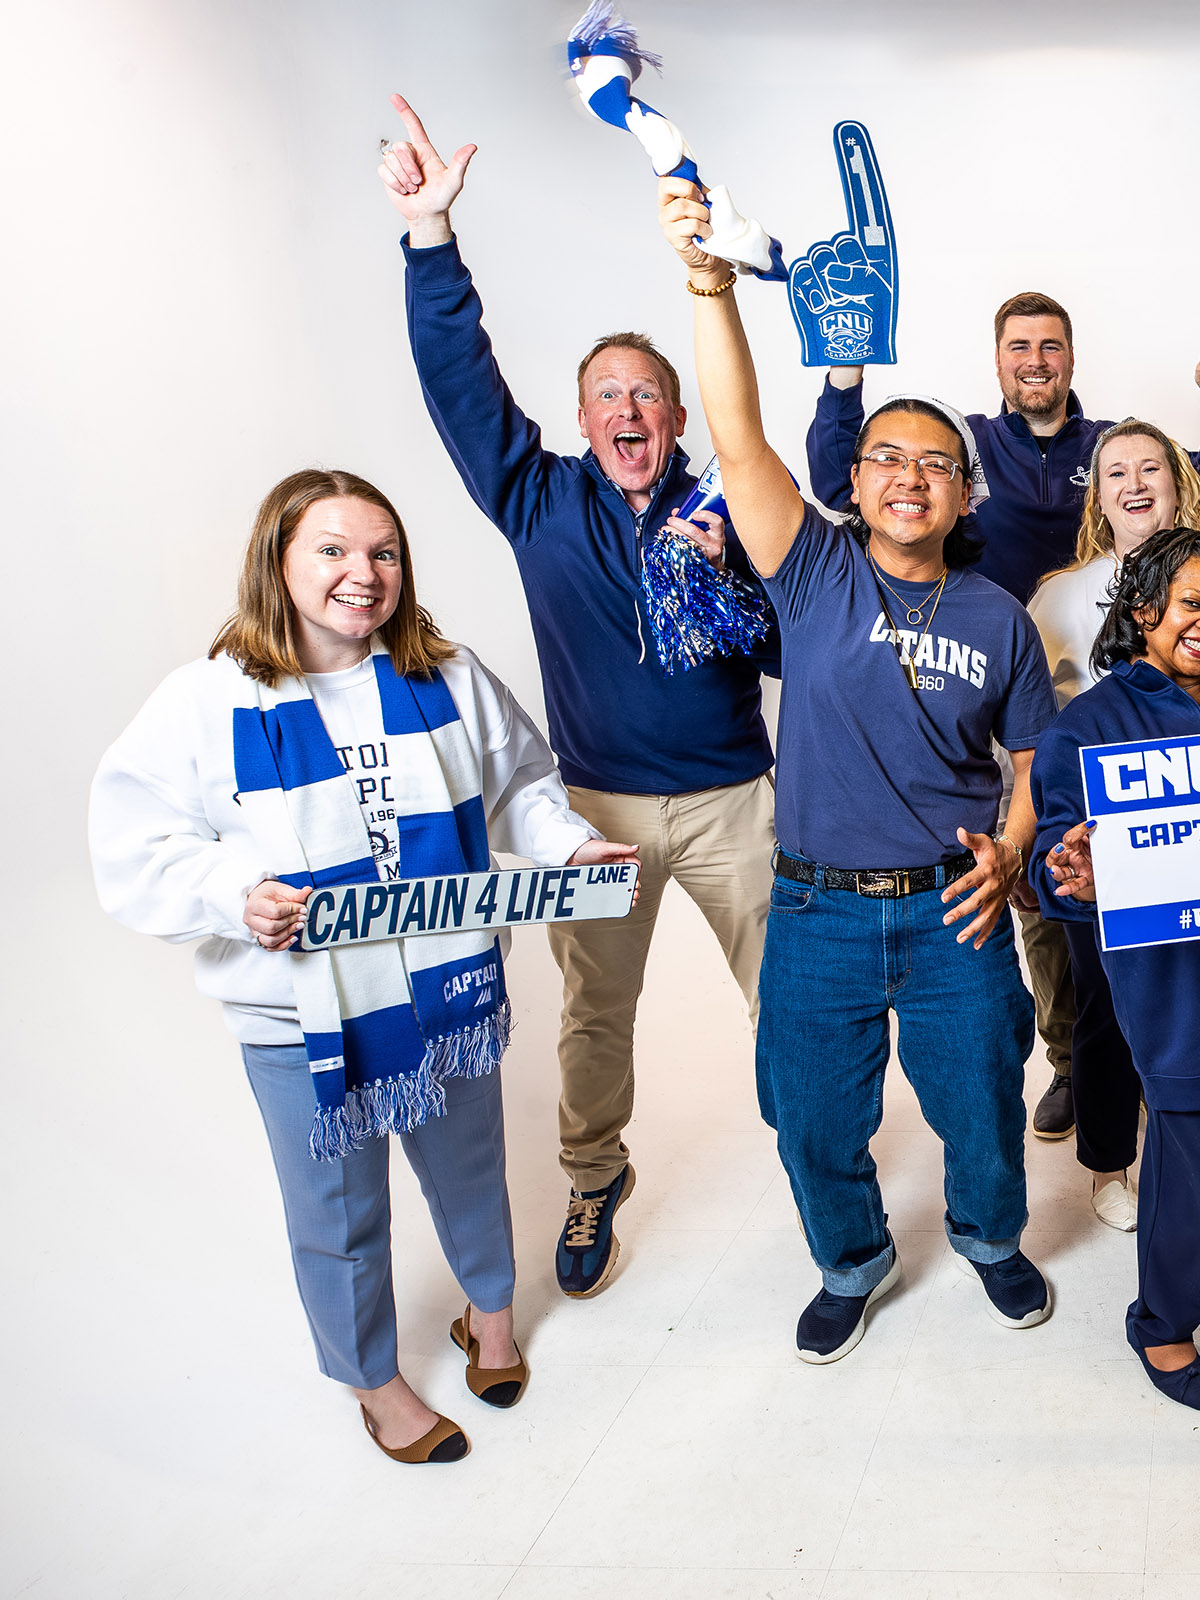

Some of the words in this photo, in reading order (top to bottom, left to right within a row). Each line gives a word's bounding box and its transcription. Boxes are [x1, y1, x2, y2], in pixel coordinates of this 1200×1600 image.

[822, 313, 869, 334] CNU
[307, 877, 470, 946] CAPTAIN
[474, 873, 500, 924] 4
[505, 868, 581, 923] LIFE
[587, 865, 631, 885] LANE
